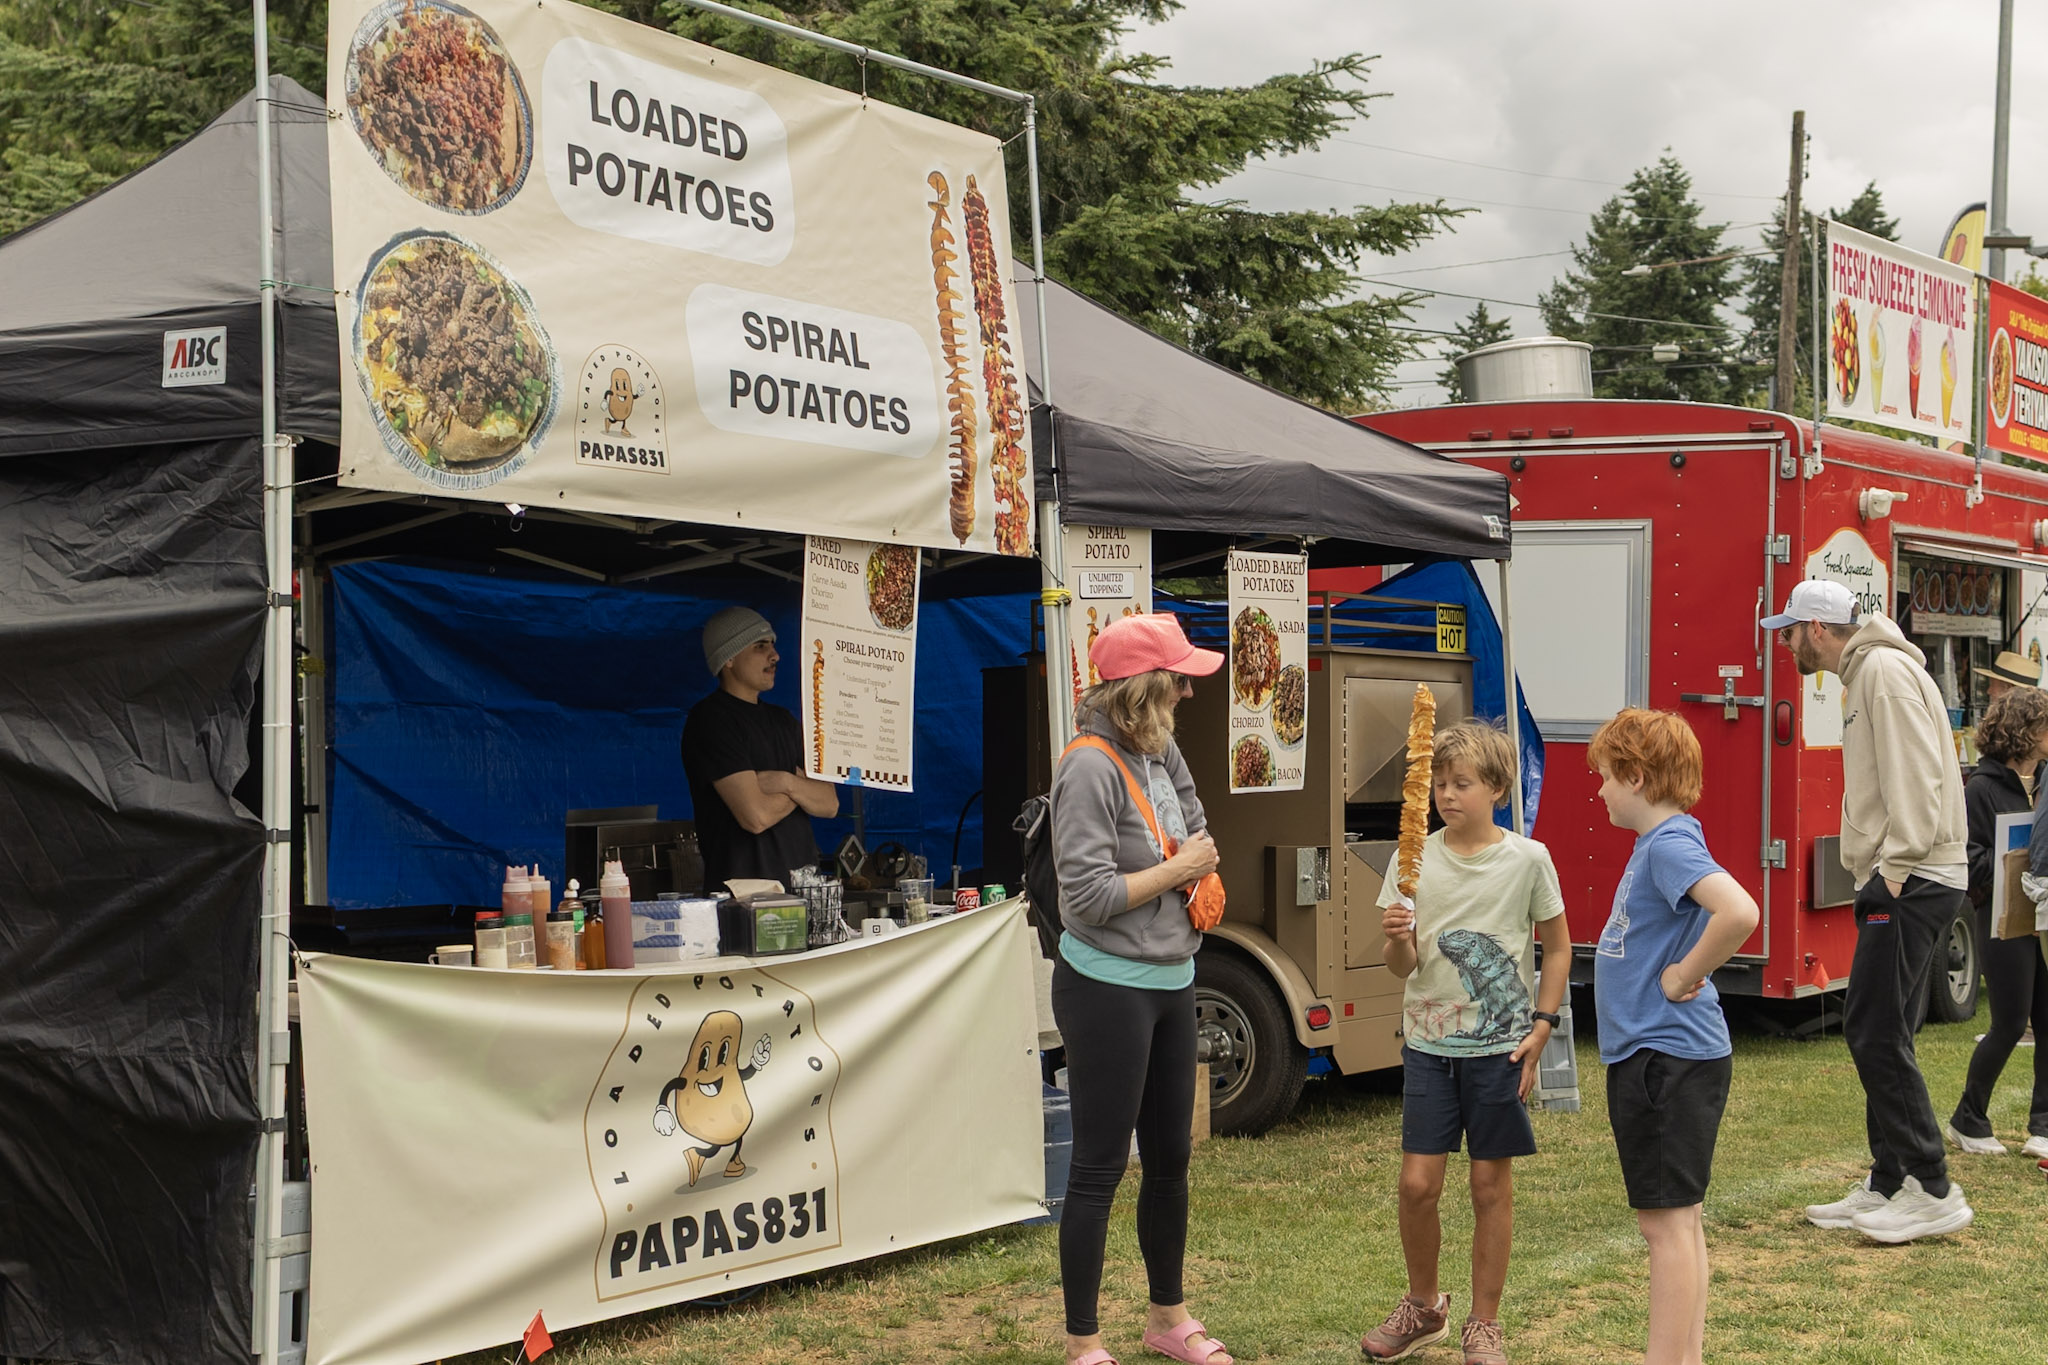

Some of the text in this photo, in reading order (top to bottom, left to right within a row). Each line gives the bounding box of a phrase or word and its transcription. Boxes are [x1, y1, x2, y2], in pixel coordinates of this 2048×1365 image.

[589, 80, 749, 162] LOADED
[567, 143, 774, 233] POTATOES
[1832, 242, 1966, 331] FRESH SQUEEZE LEMONADE
[742, 310, 870, 370] SPIRAL
[170, 335, 221, 369] ABC
[2015, 337, 2048, 386] YAKISO
[582, 351, 660, 434] LOADED POTATOES
[729, 369, 911, 435] POTATOES
[580, 440, 665, 468] PAPAS831
[1088, 525, 1127, 540] SPIRAL
[810, 536, 842, 555] BAKED
[1085, 544, 1130, 560] POTATO
[809, 551, 860, 575] POTATOES
[1231, 556, 1305, 576] LOADED BAKED
[1088, 573, 1124, 583] UNLIMITED
[1088, 584, 1124, 594] TOPPINGS!
[1242, 577, 1295, 593] POTATOES
[1439, 608, 1464, 623] CAUTION
[1277, 621, 1306, 634] ASADA
[1440, 627, 1462, 649] HOT
[835, 639, 905, 663] SPIRAL POTATO
[1232, 716, 1265, 729] CHORIZO
[1278, 767, 1303, 781] BACON
[610, 1186, 828, 1279] PAPAS831
